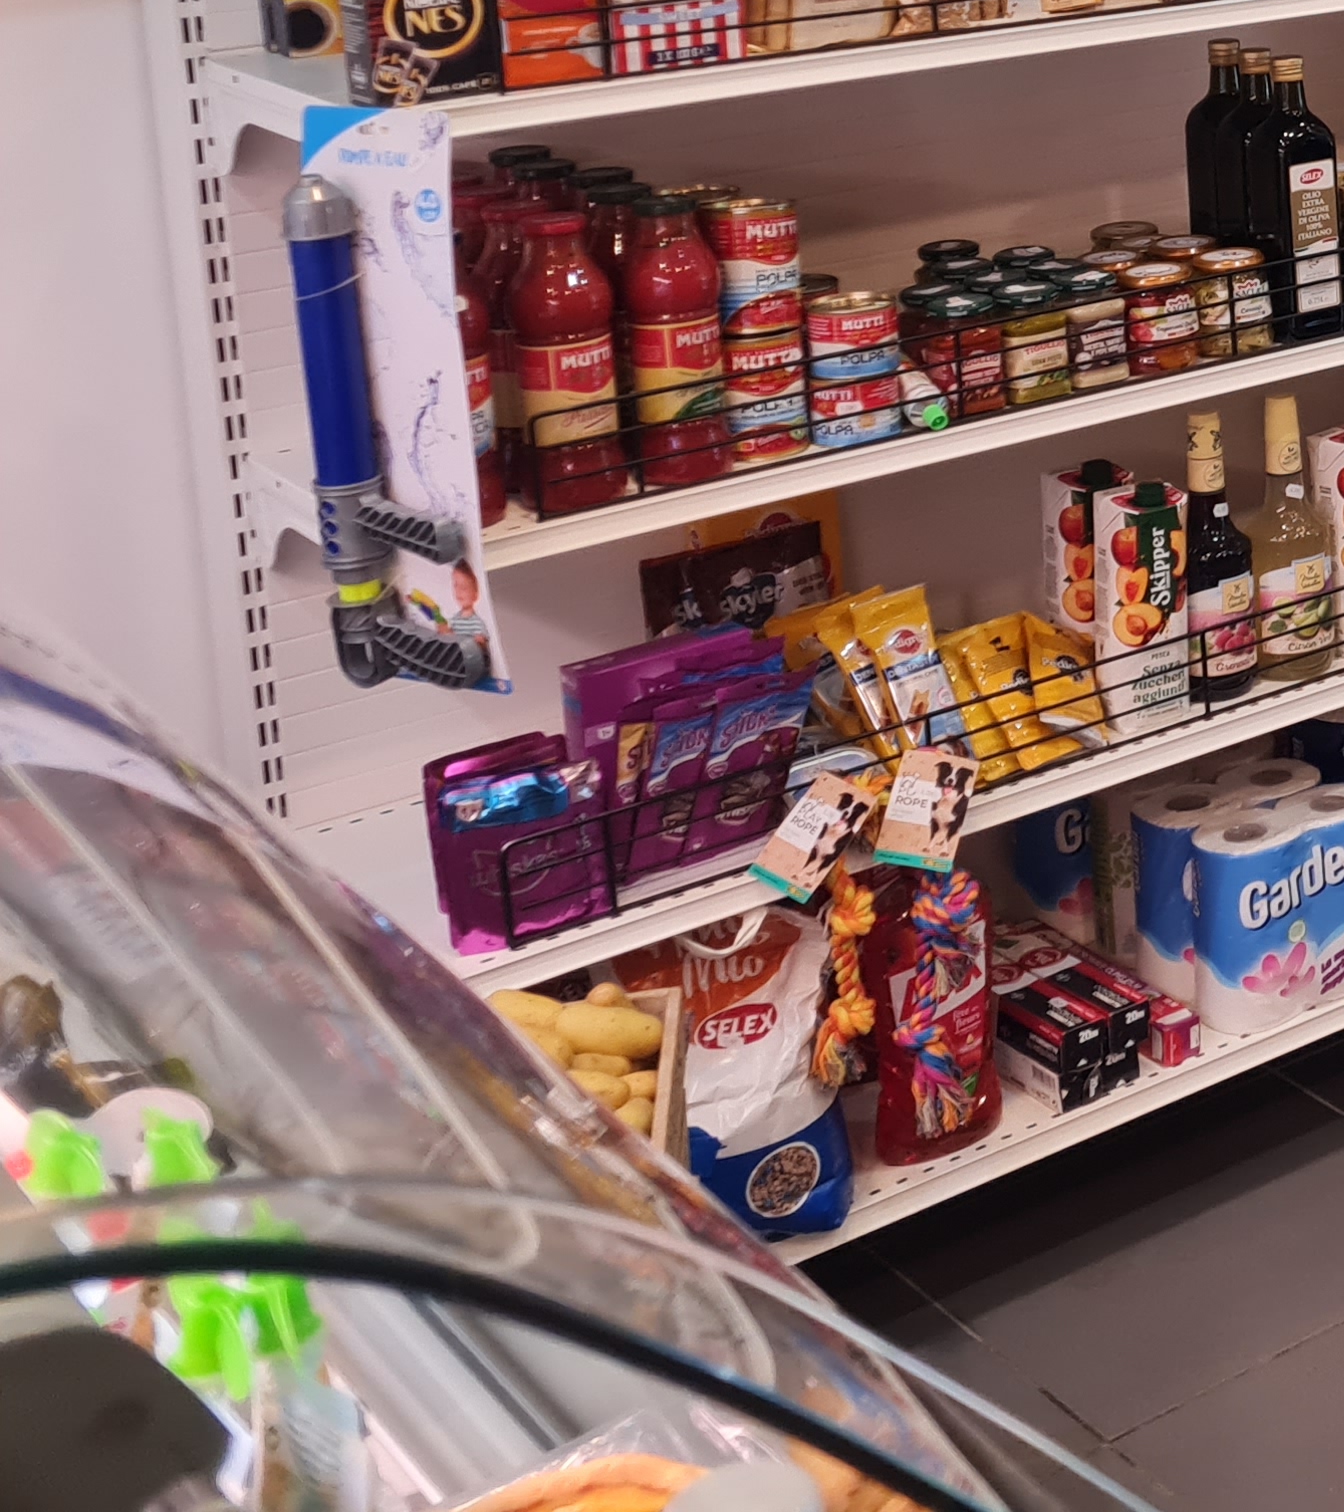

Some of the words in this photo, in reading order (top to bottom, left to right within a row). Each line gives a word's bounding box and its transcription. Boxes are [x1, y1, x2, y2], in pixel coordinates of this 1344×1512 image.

[1301, 169, 1323, 182] SELEX
[1302, 190, 1322, 200] OLIO
[1302, 198, 1325, 208] EXTRA
[1298, 205, 1330, 218] VERGINE
[1308, 212, 1331, 224] OLIVA
[1298, 227, 1333, 241] ITALIANO
[841, 314, 885, 331] MUTTI
[840, 348, 886, 367] POLPA
[1149, 526, 1172, 609] Skipper
[1142, 658, 1182, 678] Senza
[894, 794, 928, 810] ROPE
[789, 815, 819, 836] ROPE
[704, 1007, 775, 1041] SELEX
